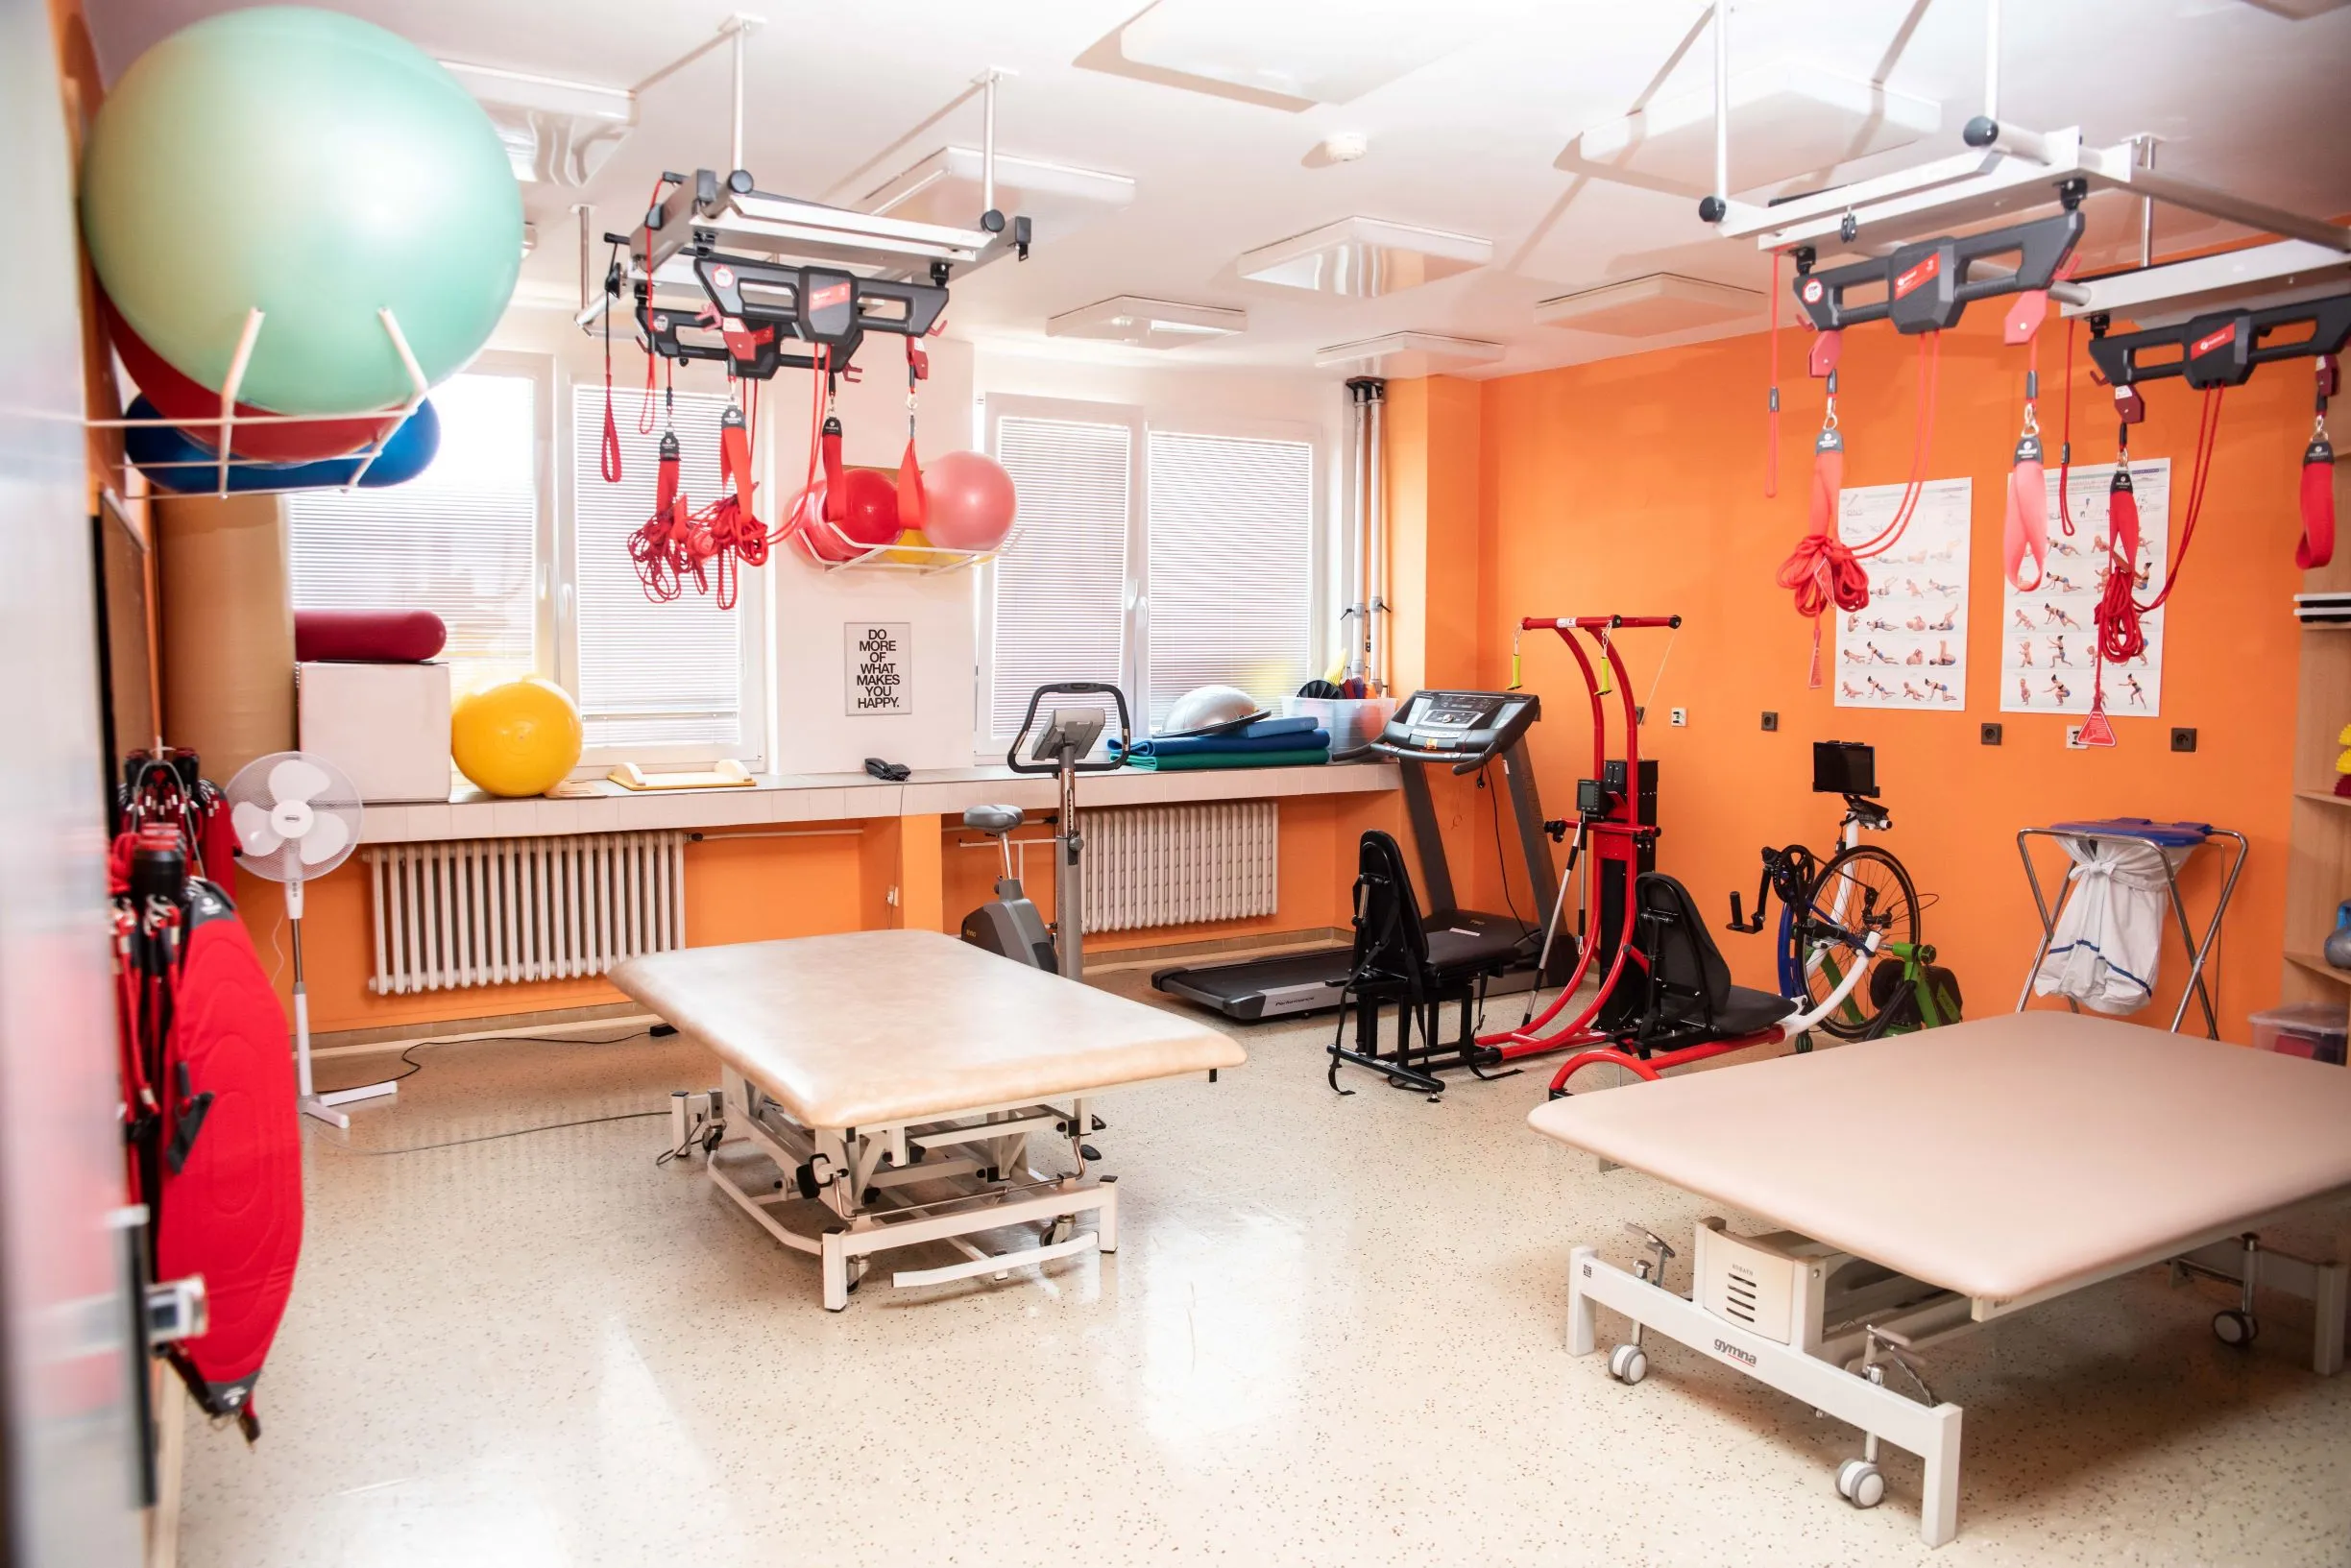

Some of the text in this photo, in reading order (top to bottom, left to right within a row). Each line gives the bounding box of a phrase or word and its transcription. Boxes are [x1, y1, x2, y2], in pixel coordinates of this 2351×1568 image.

[868, 629, 887, 640] DO
[860, 640, 897, 651] MORE
[869, 652, 886, 663] OF
[860, 663, 896, 674] WHAT
[857, 674, 901, 686] MAKES
[865, 686, 891, 696] YOU
[858, 697, 900, 709] HAPPY.
[1713, 1339, 1757, 1364] gymna
